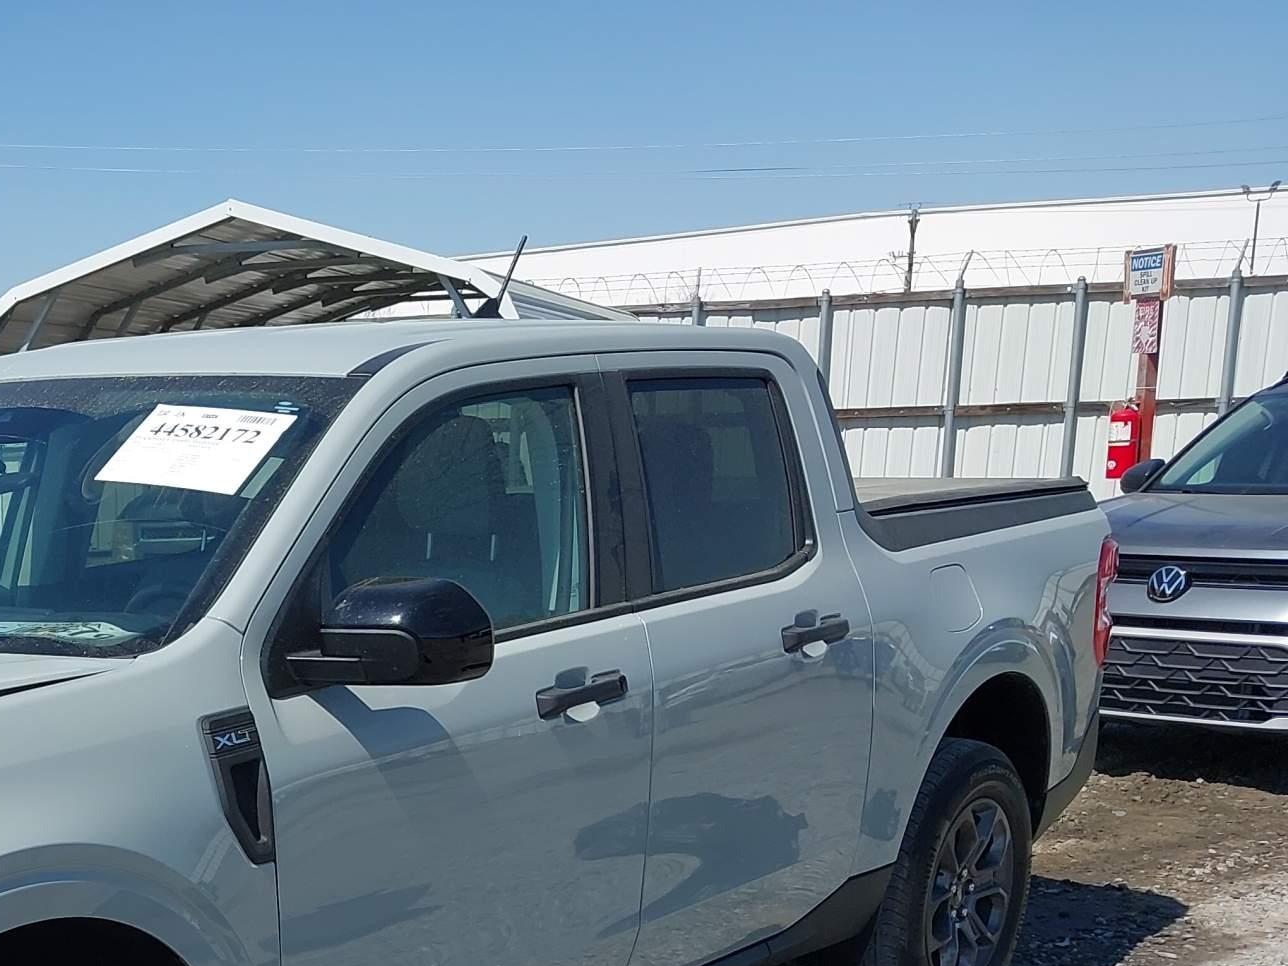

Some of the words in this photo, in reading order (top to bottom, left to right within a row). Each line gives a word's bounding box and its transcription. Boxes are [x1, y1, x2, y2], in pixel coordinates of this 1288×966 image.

[1132, 255, 1162, 270] NOTICE
[150, 421, 262, 444] 44582172
[213, 727, 257, 750] XLT
